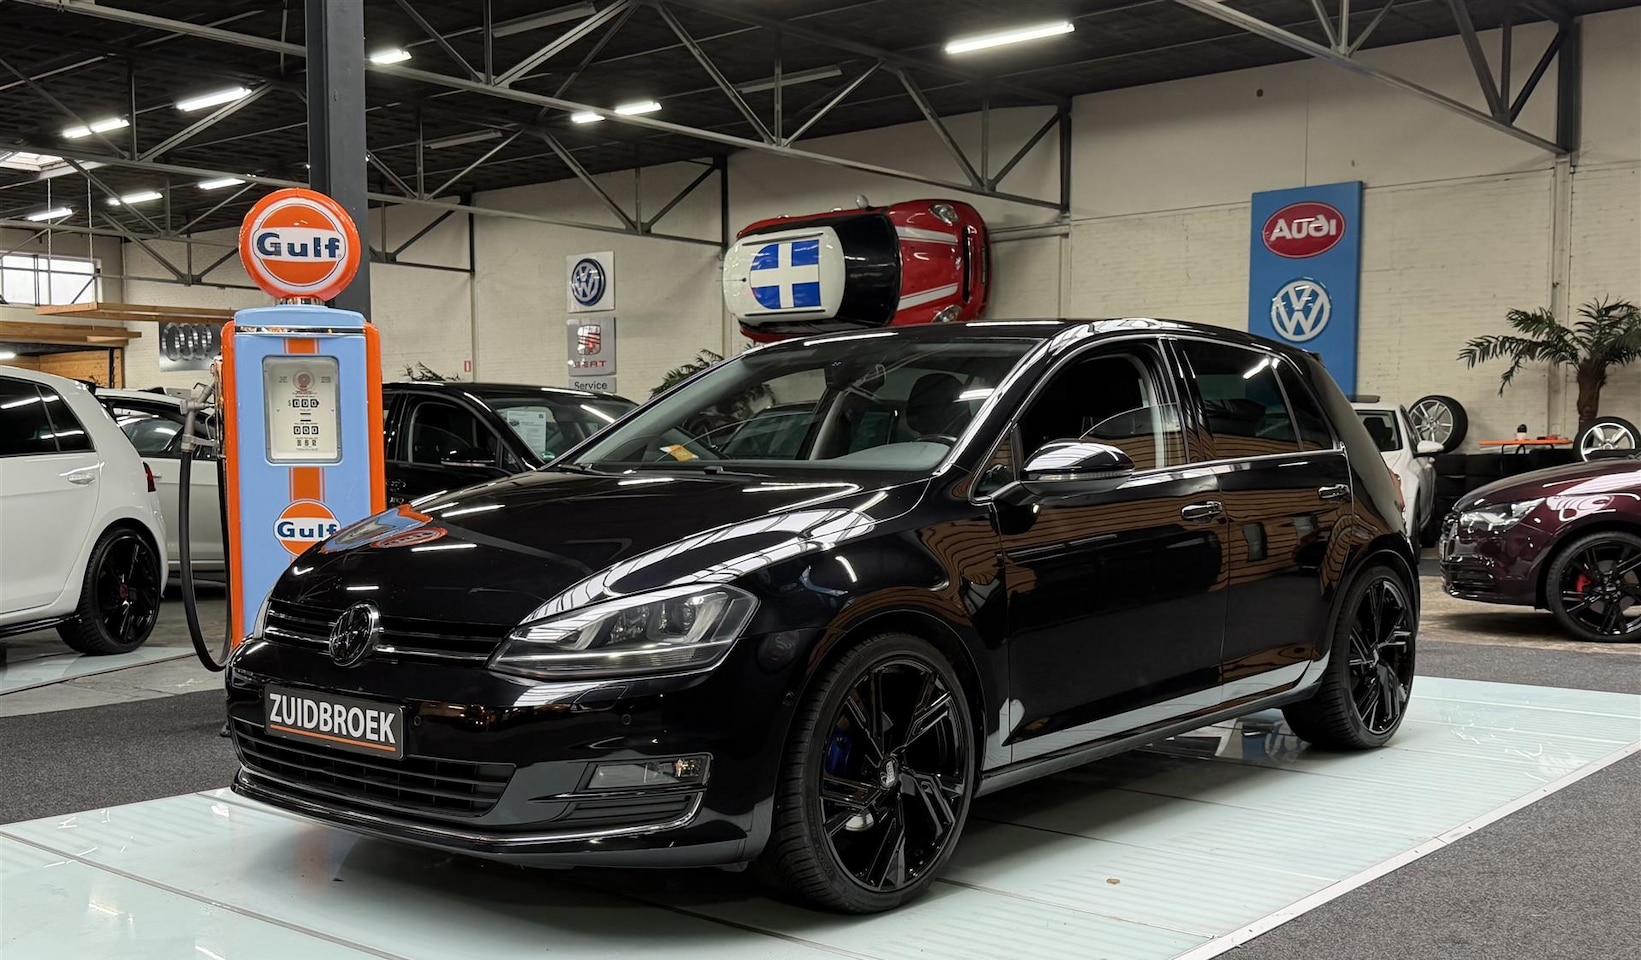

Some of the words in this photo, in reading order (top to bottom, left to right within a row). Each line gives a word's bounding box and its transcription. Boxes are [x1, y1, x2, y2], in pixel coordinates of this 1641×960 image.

[256, 232, 340, 258] Gulf
[574, 381, 608, 390] Service
[277, 521, 338, 538] Gulf
[269, 693, 397, 744] ZUIDBROEK
